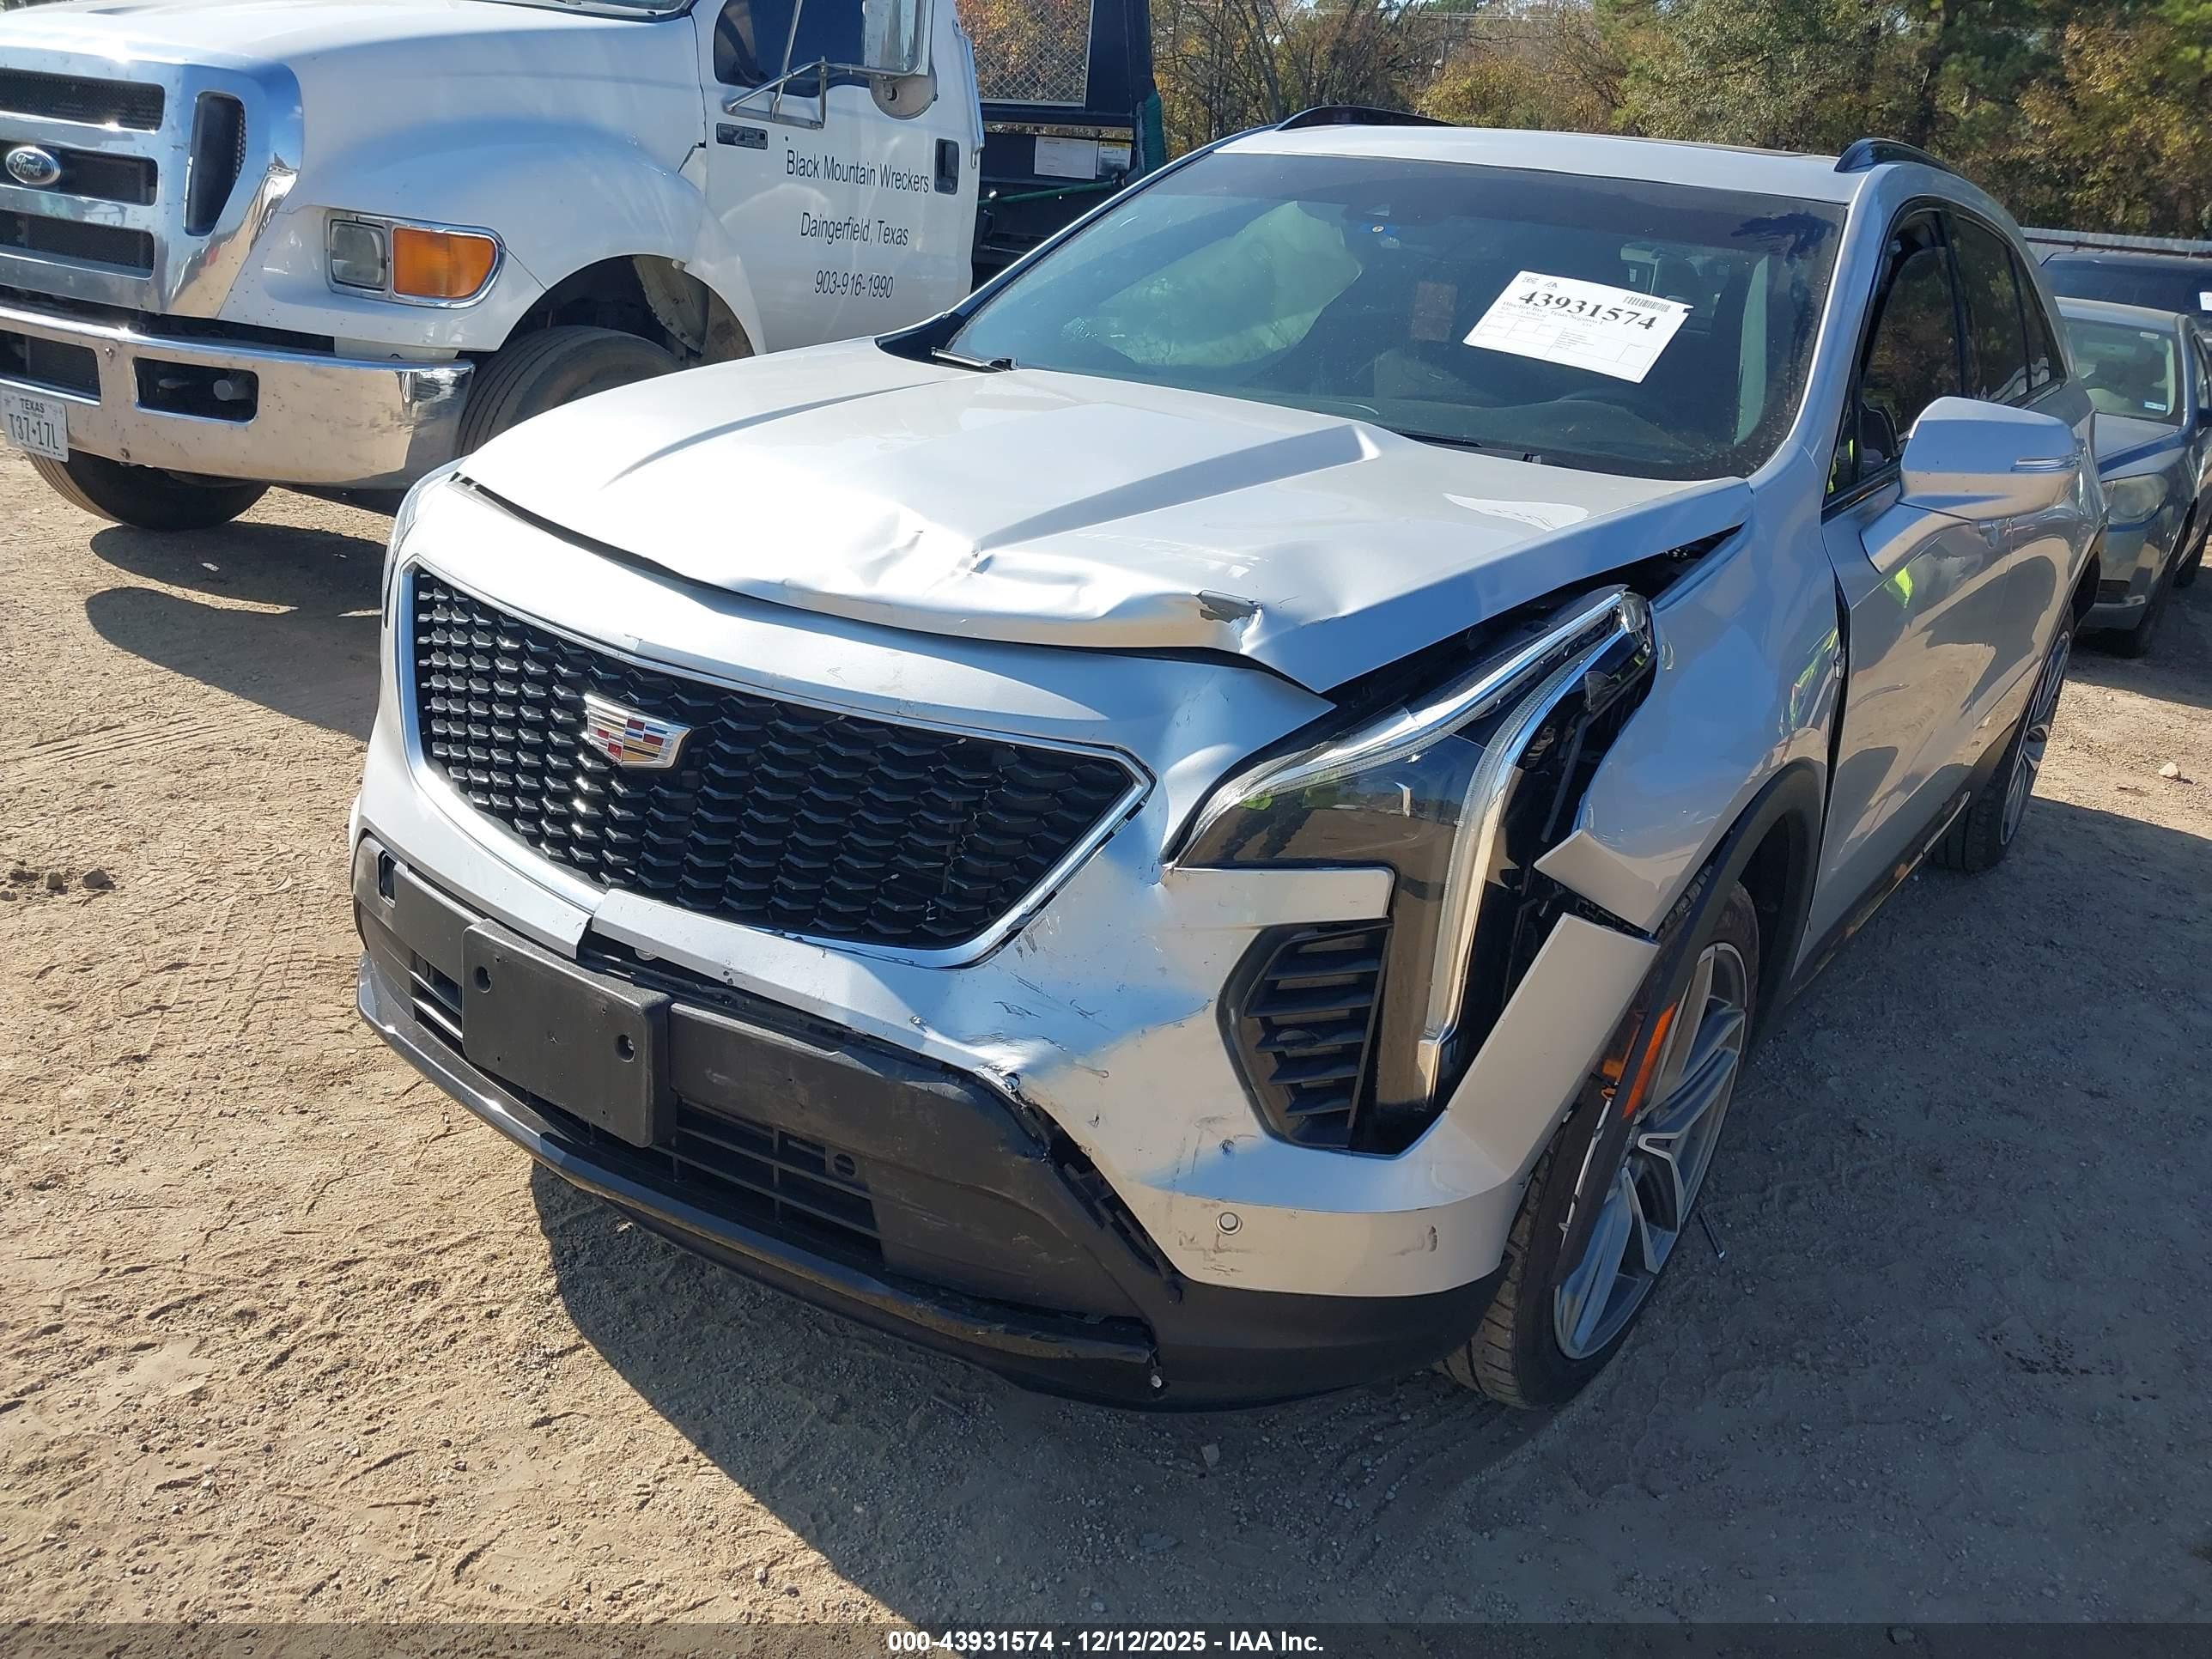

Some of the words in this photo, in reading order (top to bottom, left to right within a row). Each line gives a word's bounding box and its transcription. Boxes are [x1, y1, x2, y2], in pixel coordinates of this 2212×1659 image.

[14, 152, 42, 177] Ford
[786, 149, 820, 179] Black
[823, 155, 876, 186] Mountain
[879, 163, 930, 193] Wreckers
[800, 212, 872, 246] Daingerfield,
[877, 220, 909, 246] Texas
[814, 270, 894, 299] 903-916-1990
[1518, 290, 1657, 331] 43931574
[20, 398, 45, 413] TEXAS
